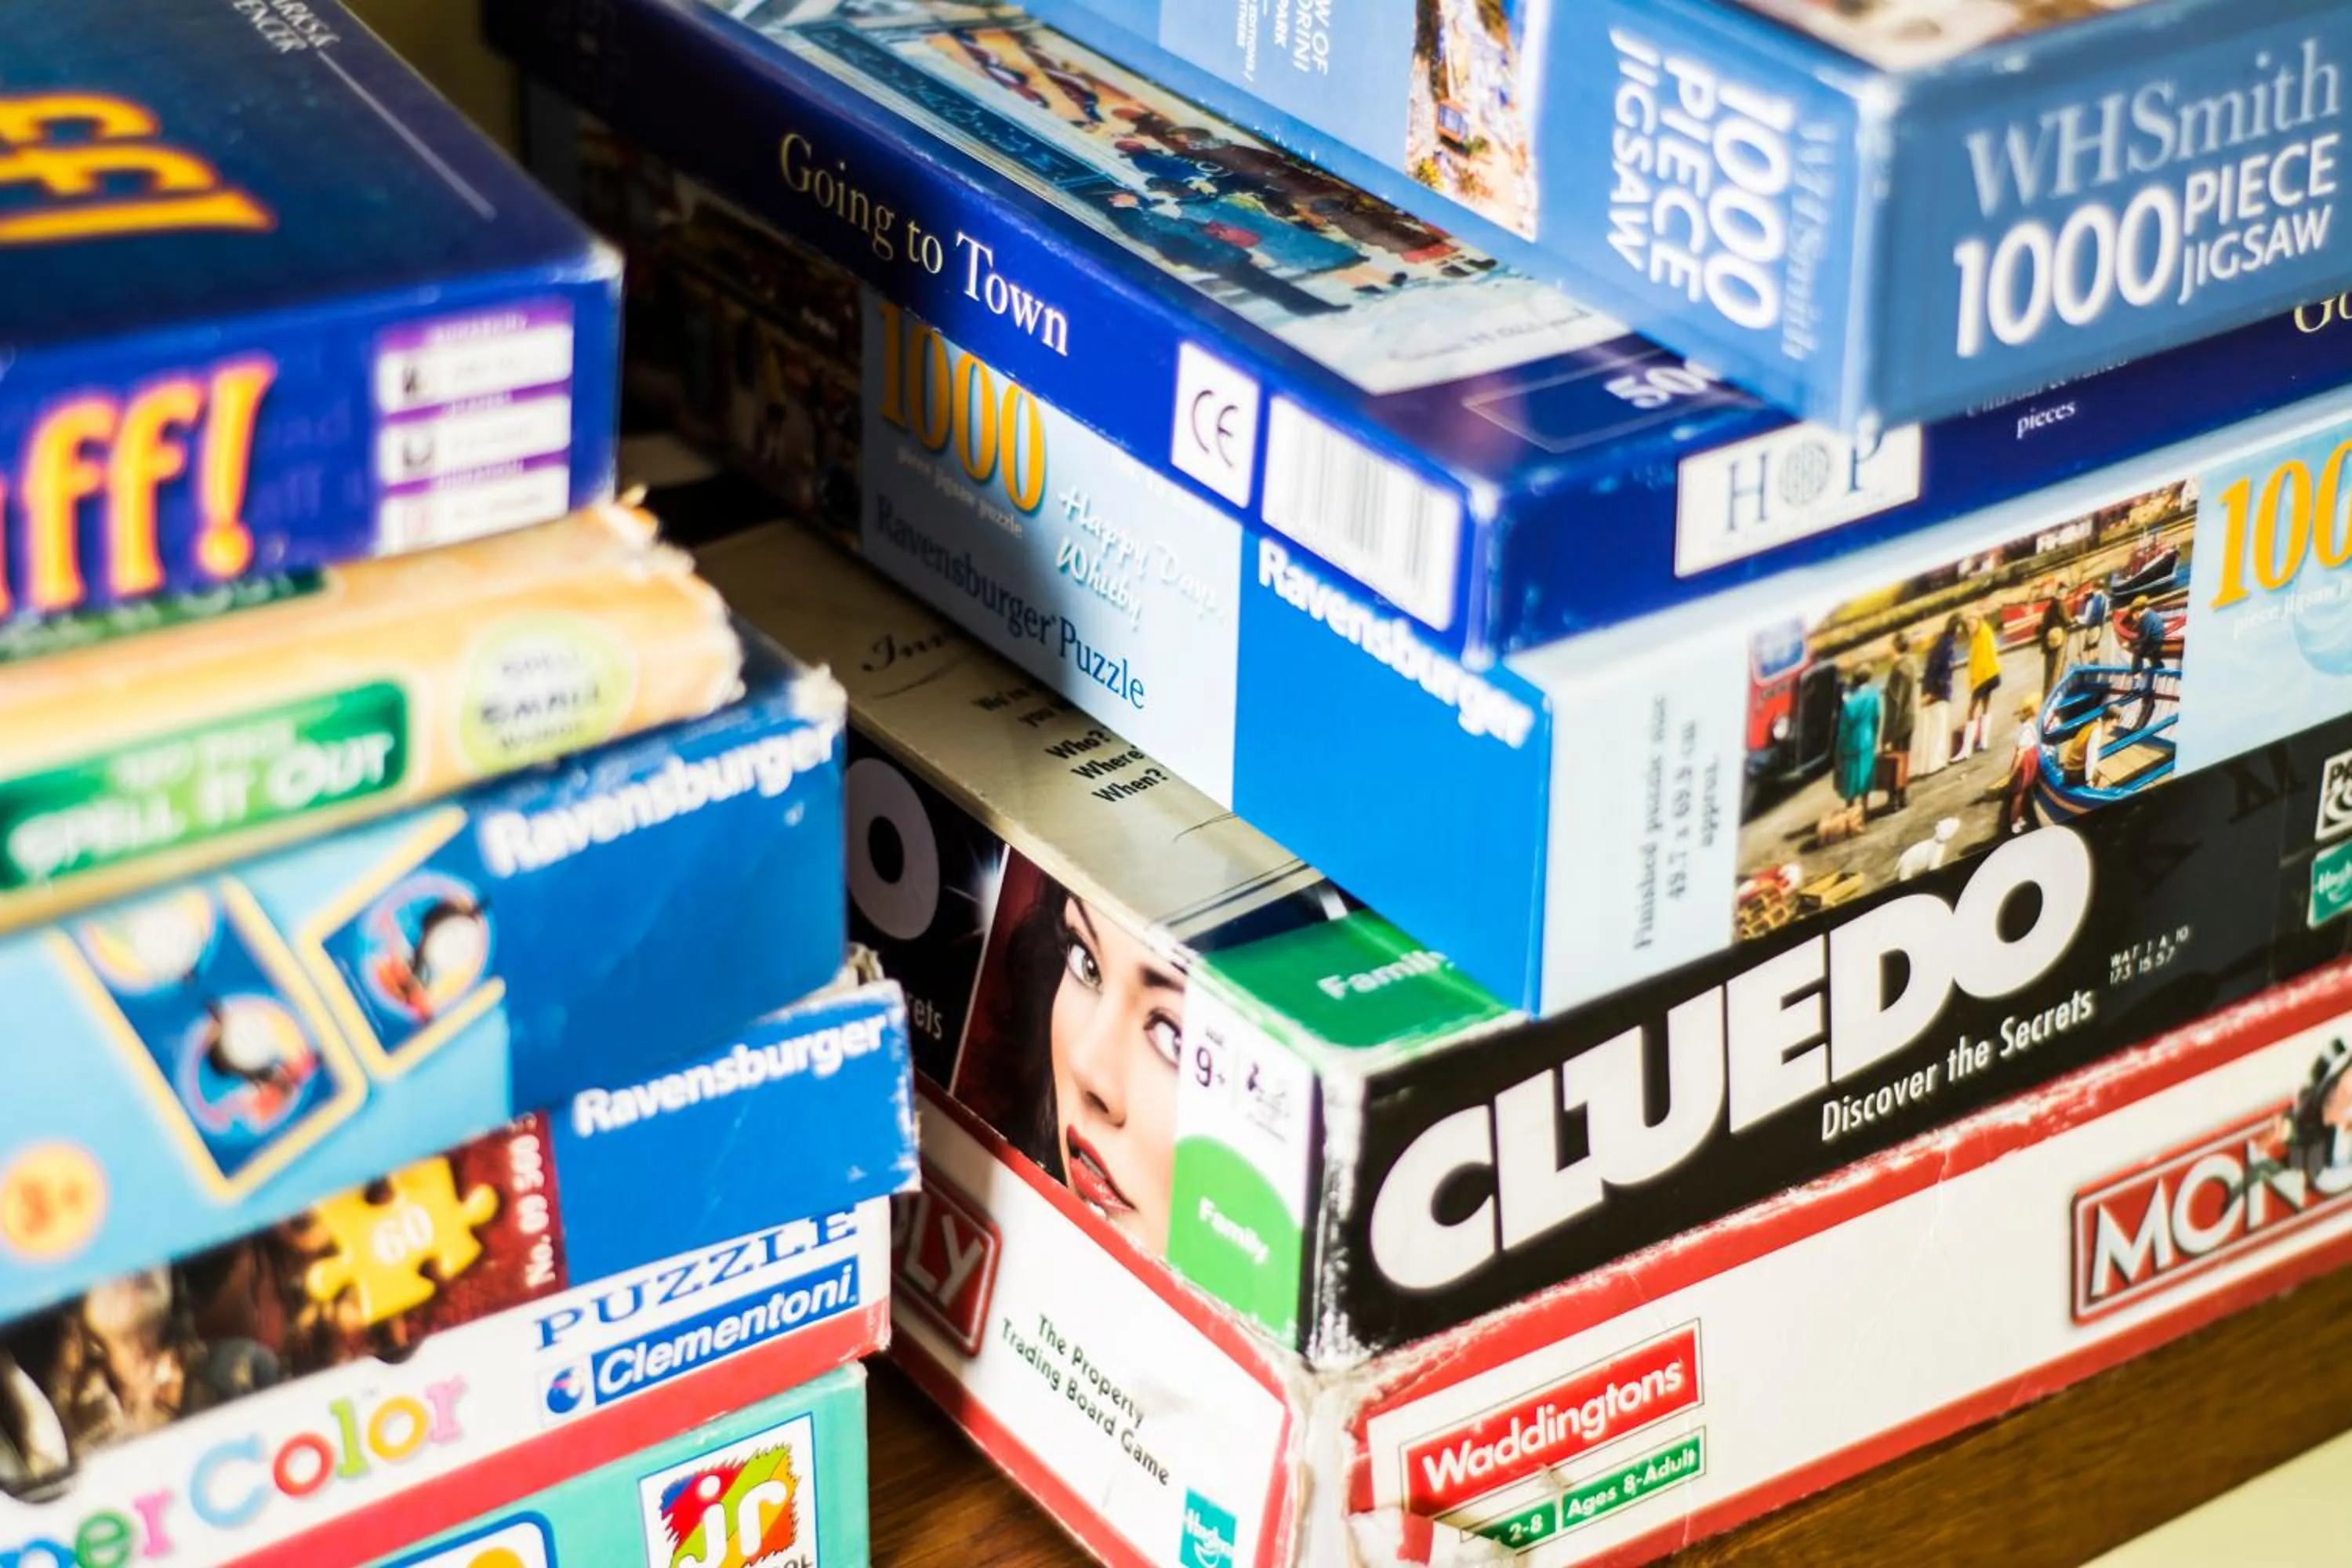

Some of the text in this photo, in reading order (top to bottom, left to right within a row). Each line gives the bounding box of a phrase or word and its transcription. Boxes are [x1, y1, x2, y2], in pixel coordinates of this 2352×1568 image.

[1312, 31, 1330, 76] OF
[1606, 27, 1662, 274] JIGSAW
[1649, 54, 1718, 304] PIECE
[1966, 36, 2342, 219] WHSmith
[2183, 132, 2341, 236] PIECE
[780, 132, 1069, 358] Going to Town
[1701, 85, 1796, 331] 1000
[1953, 183, 2180, 359] 1000
[2178, 204, 2333, 307] JIGSAW
[880, 303, 1046, 514] 1000
[2016, 401, 2077, 440] pieces
[0, 349, 277, 618] ff!
[1058, 485, 1150, 582] Happy
[1058, 615, 1145, 709] Puzzle
[1258, 537, 1535, 750] Ravensburger
[268, 731, 397, 810] OUT
[477, 720, 835, 880] Ravensburger
[1044, 728, 1112, 761] Who?
[1091, 767, 1170, 804] When?
[572, 1014, 889, 1138] Ravensburger
[1370, 824, 2092, 1290] CLUEDO
[1820, 989, 2096, 1143] Discover the Secrets
[371, 1202, 435, 1265] 60
[535, 1209, 859, 1351] PUZZLE
[1198, 1195, 1270, 1269] Family
[1001, 1317, 1171, 1486] Trading Board Game
[1039, 1312, 1145, 1430] The Property
[1421, 1357, 1685, 1494] Waddingtons
[189, 1374, 466, 1529] Color
[1566, 1445, 1698, 1519] Ages 8-Adult
[1507, 1512, 1544, 1546] 2-8
